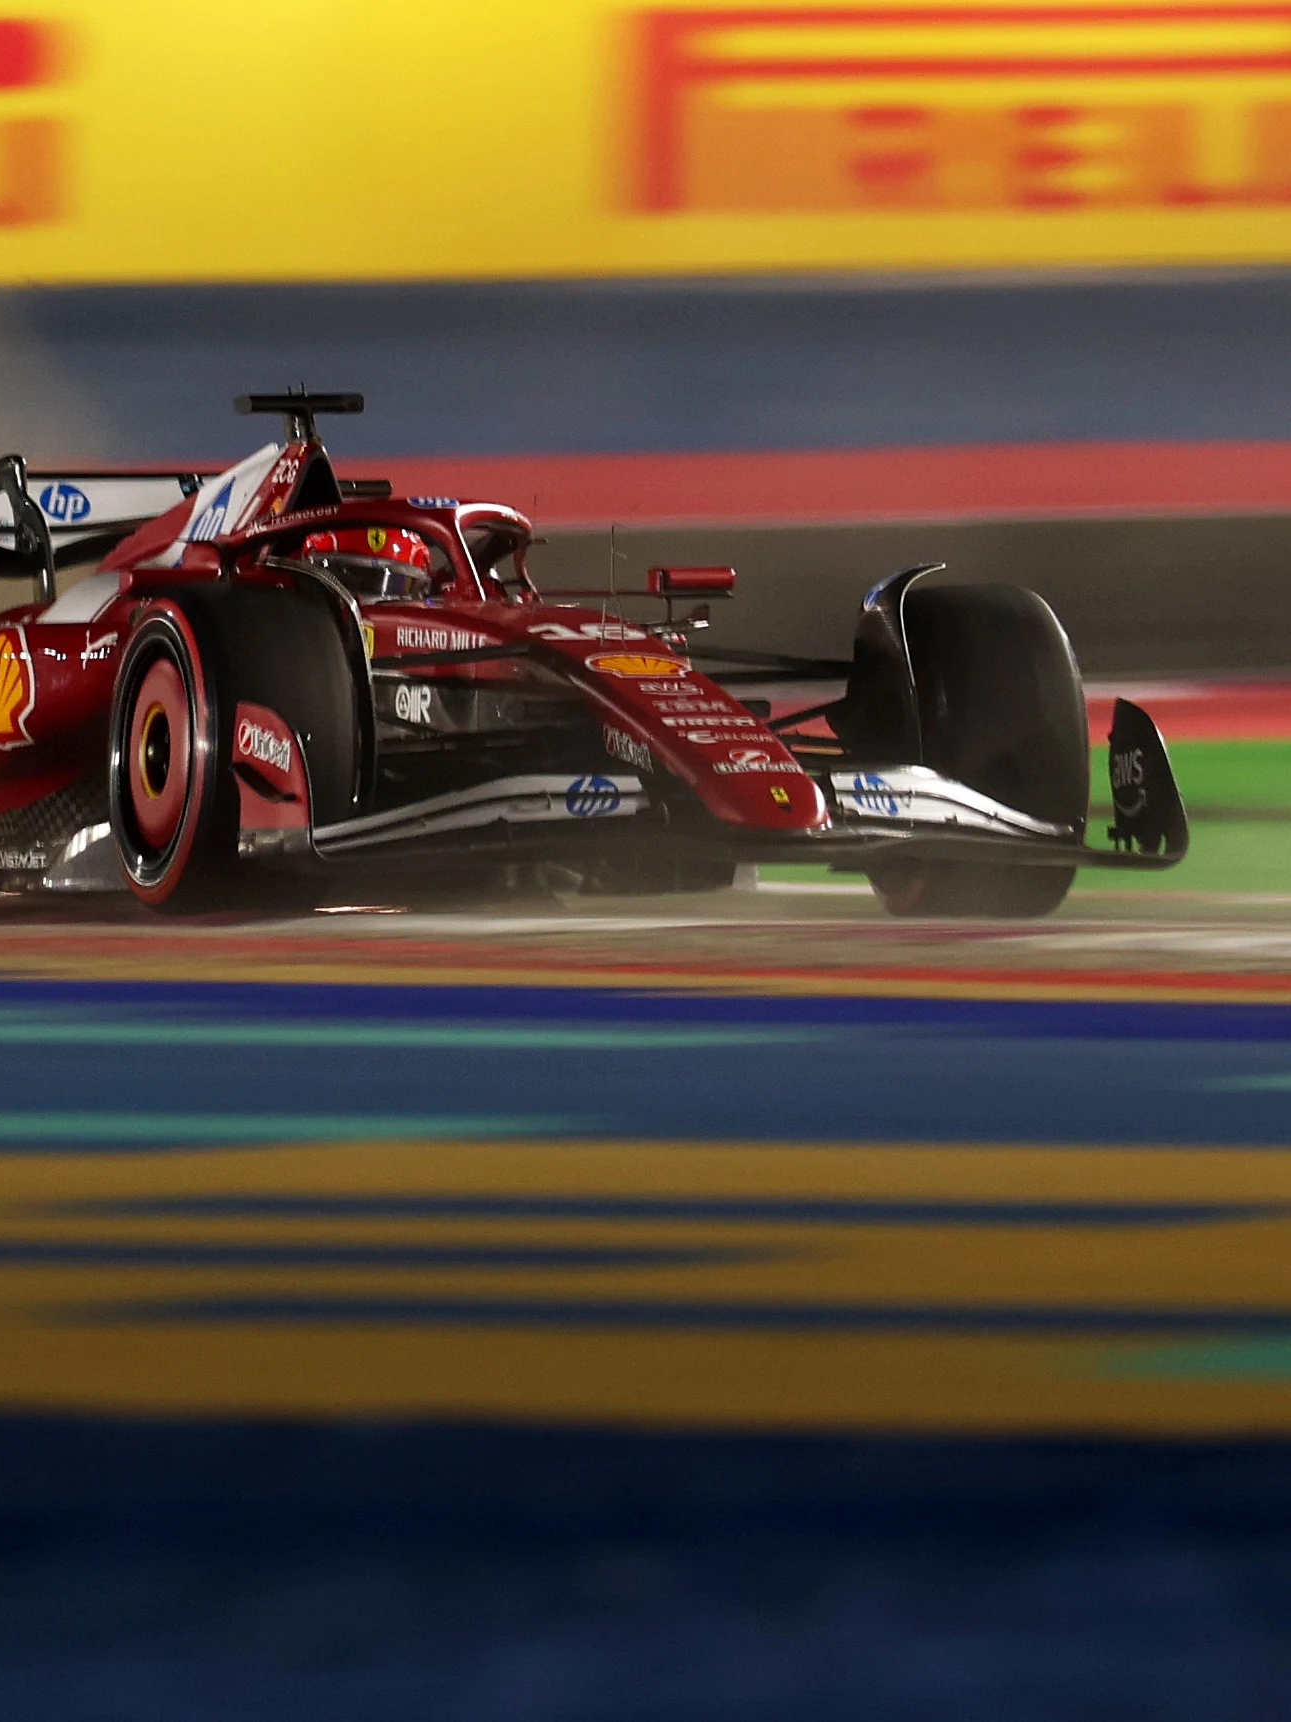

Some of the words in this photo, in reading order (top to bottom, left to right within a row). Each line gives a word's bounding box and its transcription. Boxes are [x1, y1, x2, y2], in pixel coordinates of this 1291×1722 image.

[46, 482, 85, 521] hp
[396, 626, 448, 650] RICHARD
[527, 622, 647, 641] 16
